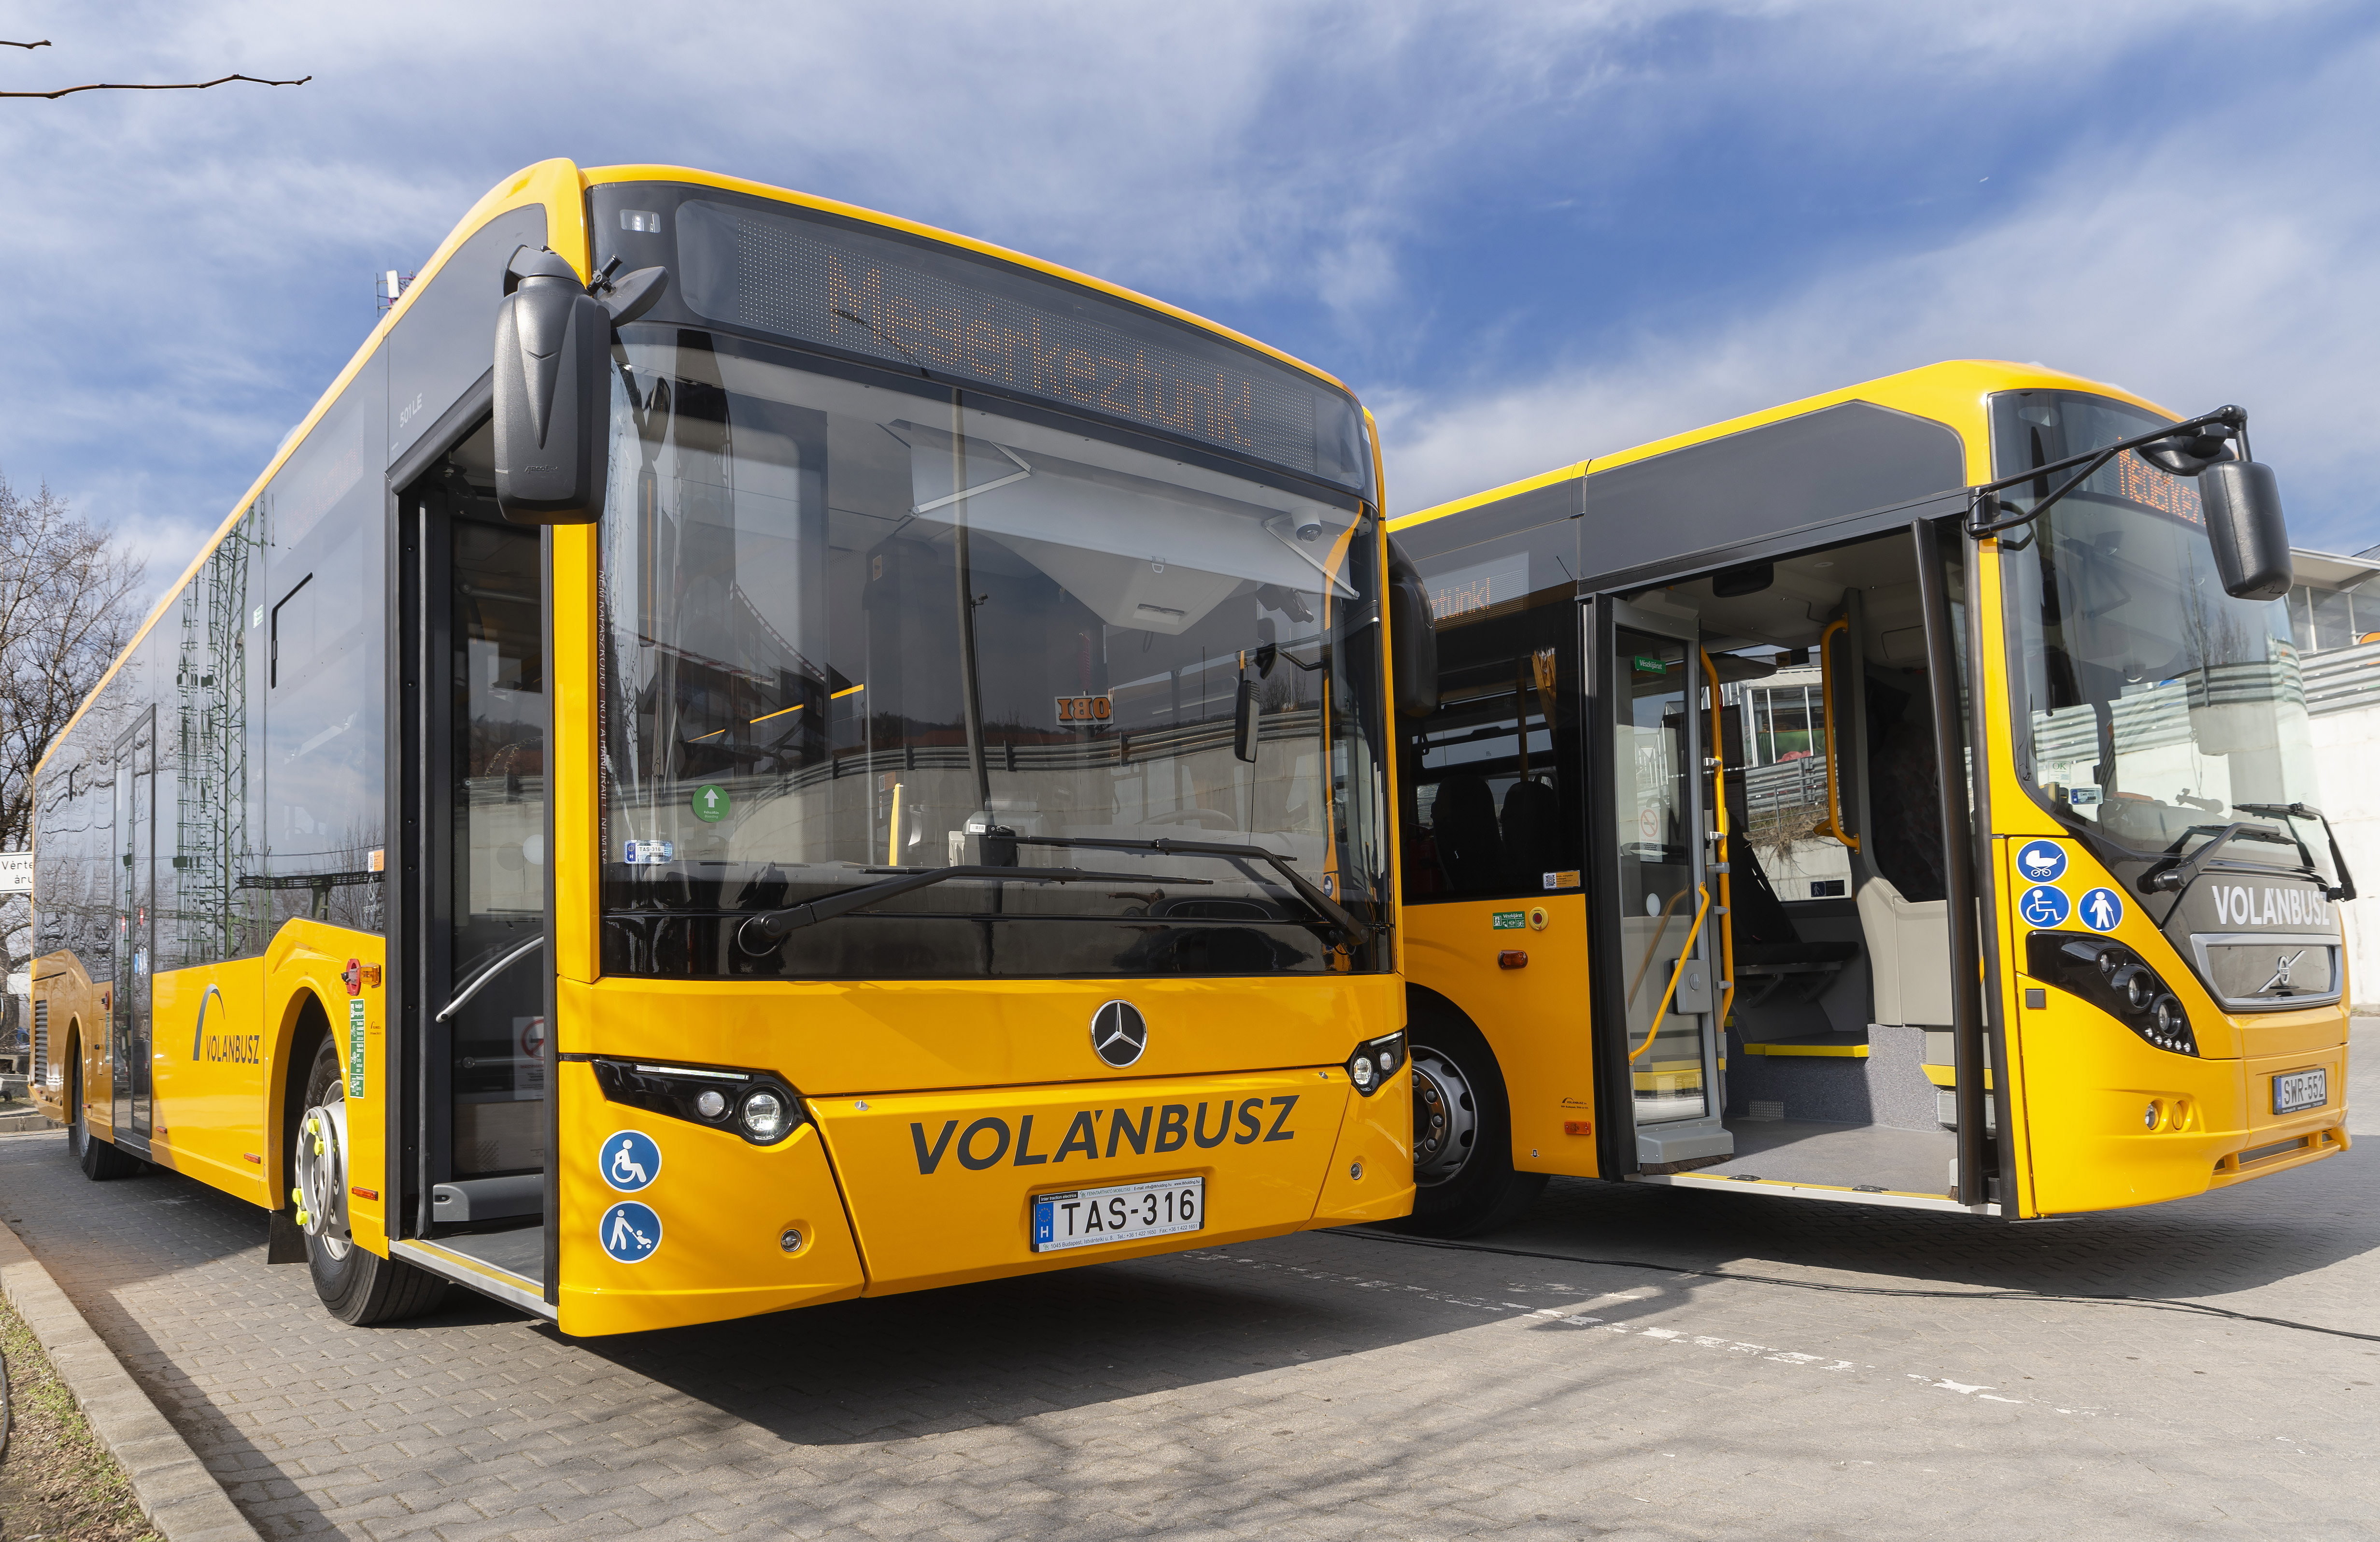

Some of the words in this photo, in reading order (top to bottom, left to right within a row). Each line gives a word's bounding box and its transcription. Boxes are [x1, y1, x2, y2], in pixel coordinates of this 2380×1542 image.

[829, 254, 1252, 447] Megérkeztünk!
[1639, 659, 1662, 670] Vészkijárat
[2211, 885, 2330, 925] VOLÁNBUSZ
[206, 1035, 260, 1064] VOLÁNBUSZ
[2284, 1073, 2323, 1105] SWR-552
[910, 1095, 1300, 1175] VOLÁNBUSZ
[1061, 1189, 1194, 1236] TAS-316
[1040, 1226, 1049, 1238] H
